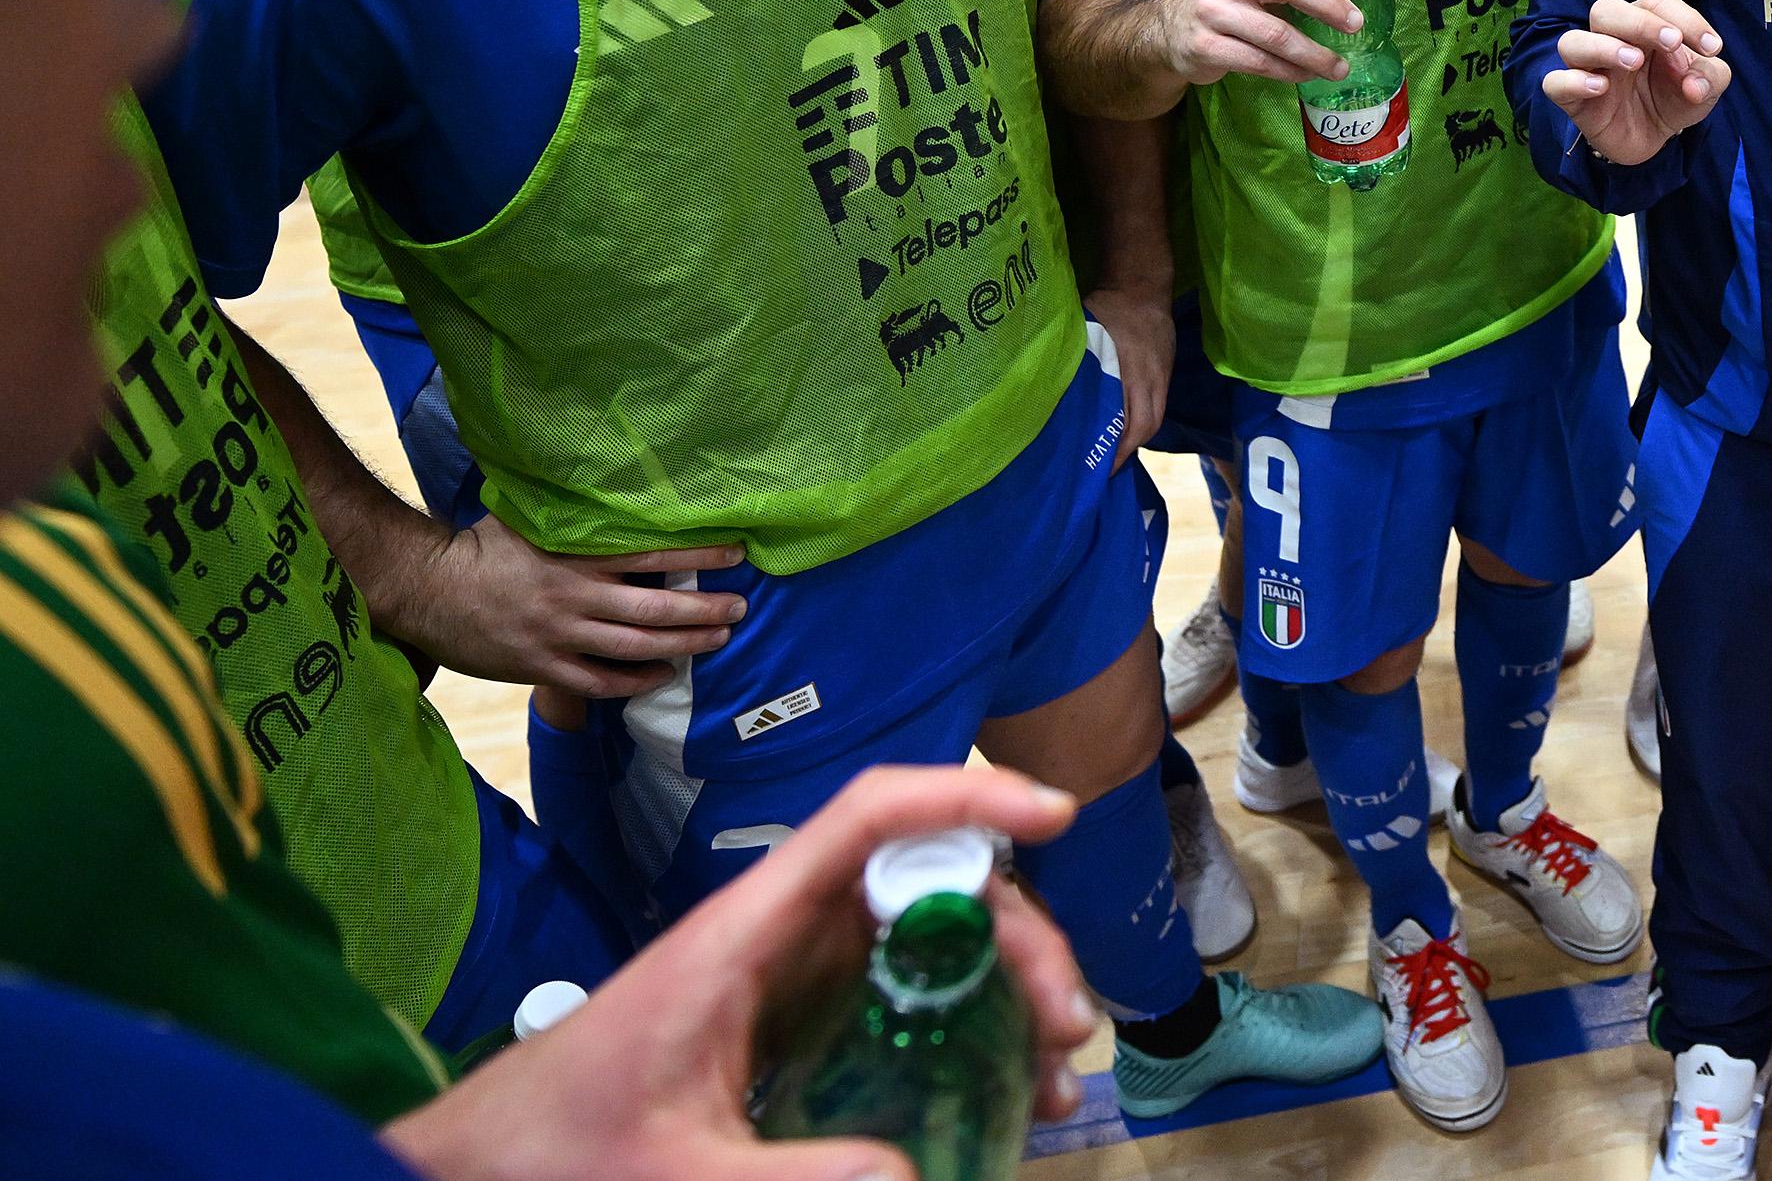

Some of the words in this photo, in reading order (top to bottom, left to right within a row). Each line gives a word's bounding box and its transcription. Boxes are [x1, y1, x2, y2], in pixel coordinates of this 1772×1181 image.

[807, 96, 1008, 226] Poste
[1318, 114, 1375, 140] Lete
[891, 176, 1021, 276] Telepass
[966, 220, 1039, 333] eni
[1248, 435, 1301, 564] 9
[1262, 582, 1301, 604] ITALIA
